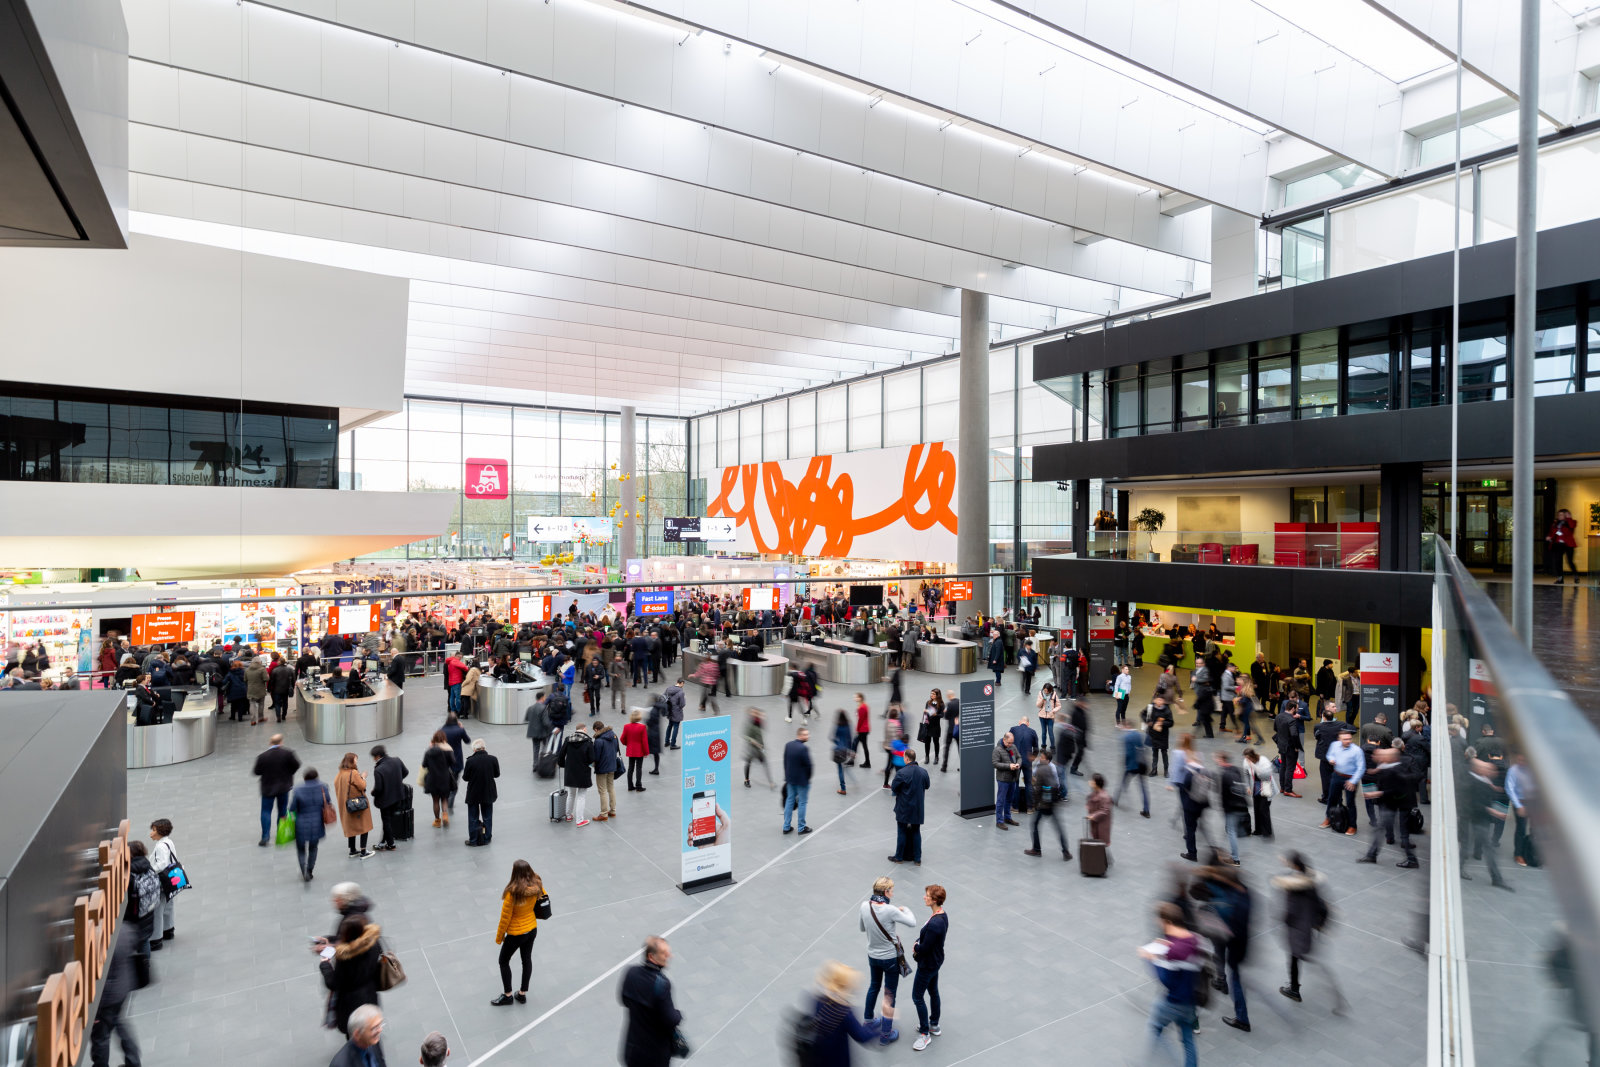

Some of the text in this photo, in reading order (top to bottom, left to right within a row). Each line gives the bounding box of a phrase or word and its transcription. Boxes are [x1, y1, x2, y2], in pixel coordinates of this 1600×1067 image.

[331, 617, 336, 626] 3
[372, 614, 378, 622] 4
[136, 626, 141, 635] 1
[185, 623, 191, 632] 2
[711, 742, 723, 752] 365
[713, 750, 726, 758] days
